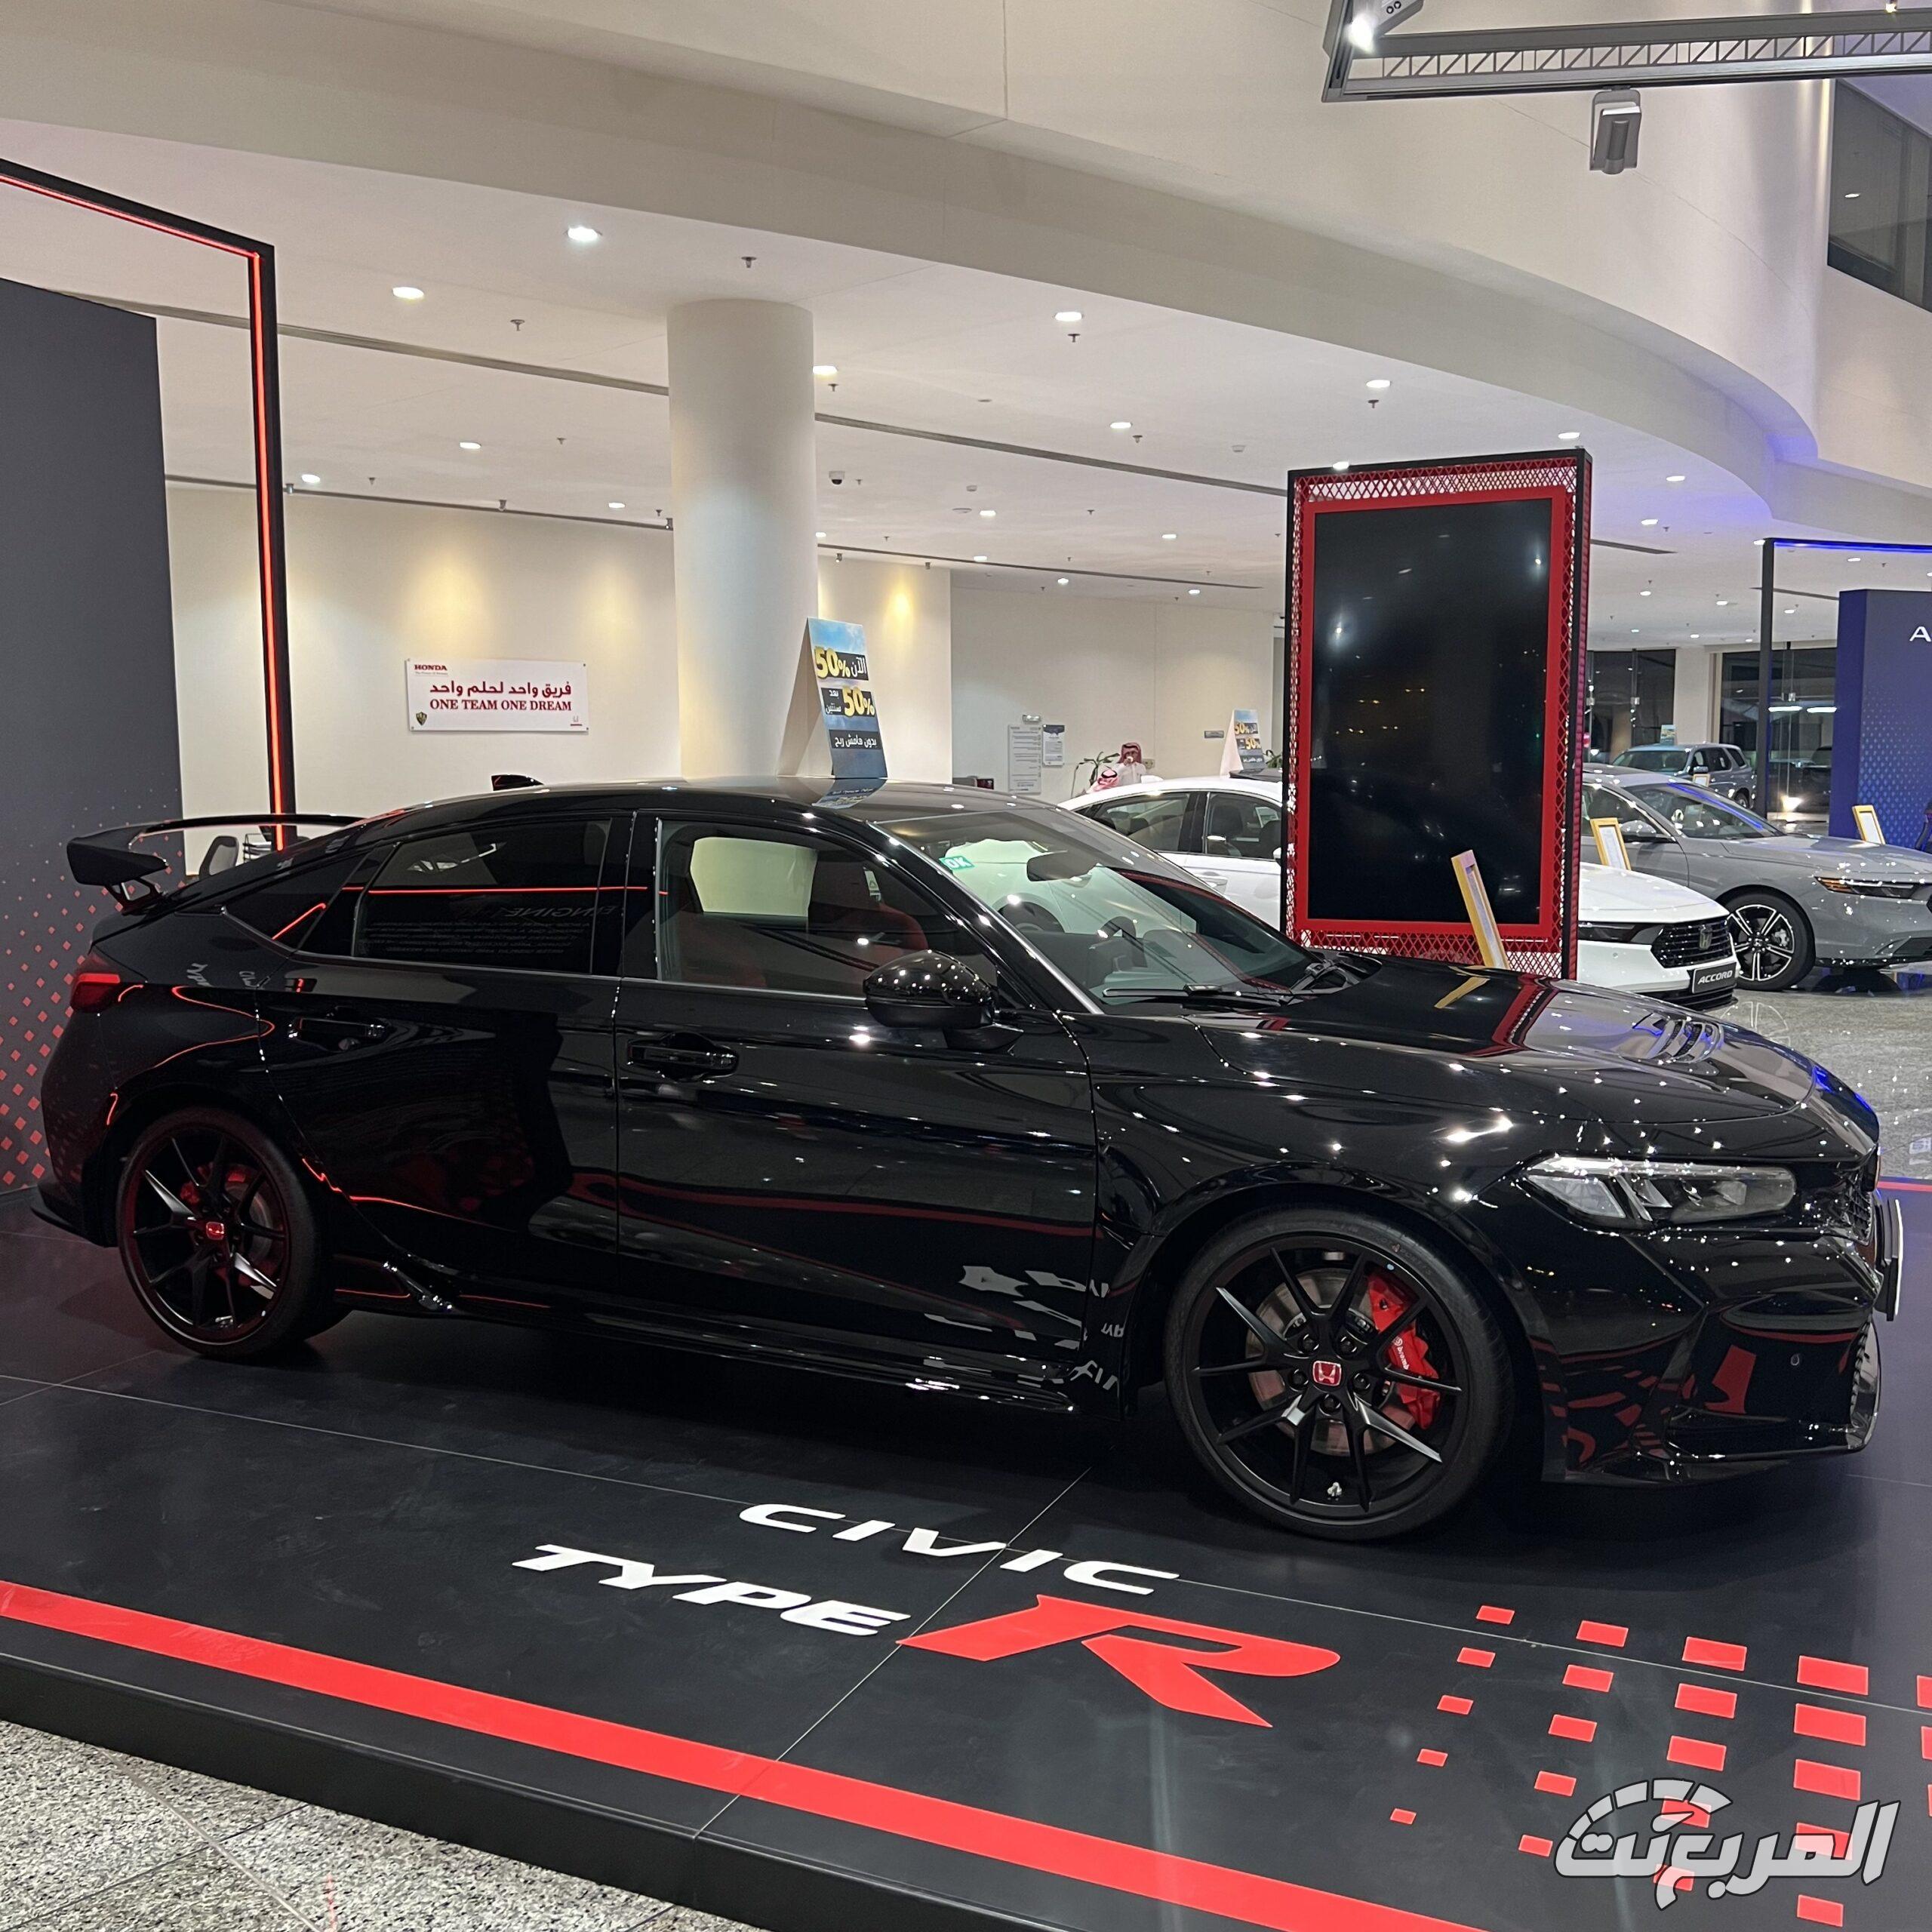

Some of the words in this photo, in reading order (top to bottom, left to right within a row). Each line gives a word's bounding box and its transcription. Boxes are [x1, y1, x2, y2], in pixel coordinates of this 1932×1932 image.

[815, 647, 850, 678] 50%
[430, 680, 463, 696] واحد
[467, 681, 503, 697] لحلم
[509, 681, 537, 697] واحد
[542, 681, 571, 697] فريق
[429, 698, 459, 709] ONE
[461, 699, 498, 710] TEAM
[500, 700, 528, 710] ONE
[530, 700, 571, 710] DREAM
[843, 686, 875, 716] 50%
[944, 857, 972, 868] OK
[1697, 971, 1733, 984] ACCORD
[739, 1503, 1180, 1595] CIVIC
[511, 1544, 912, 1637] TYPE
[895, 1593, 1341, 1728] R
